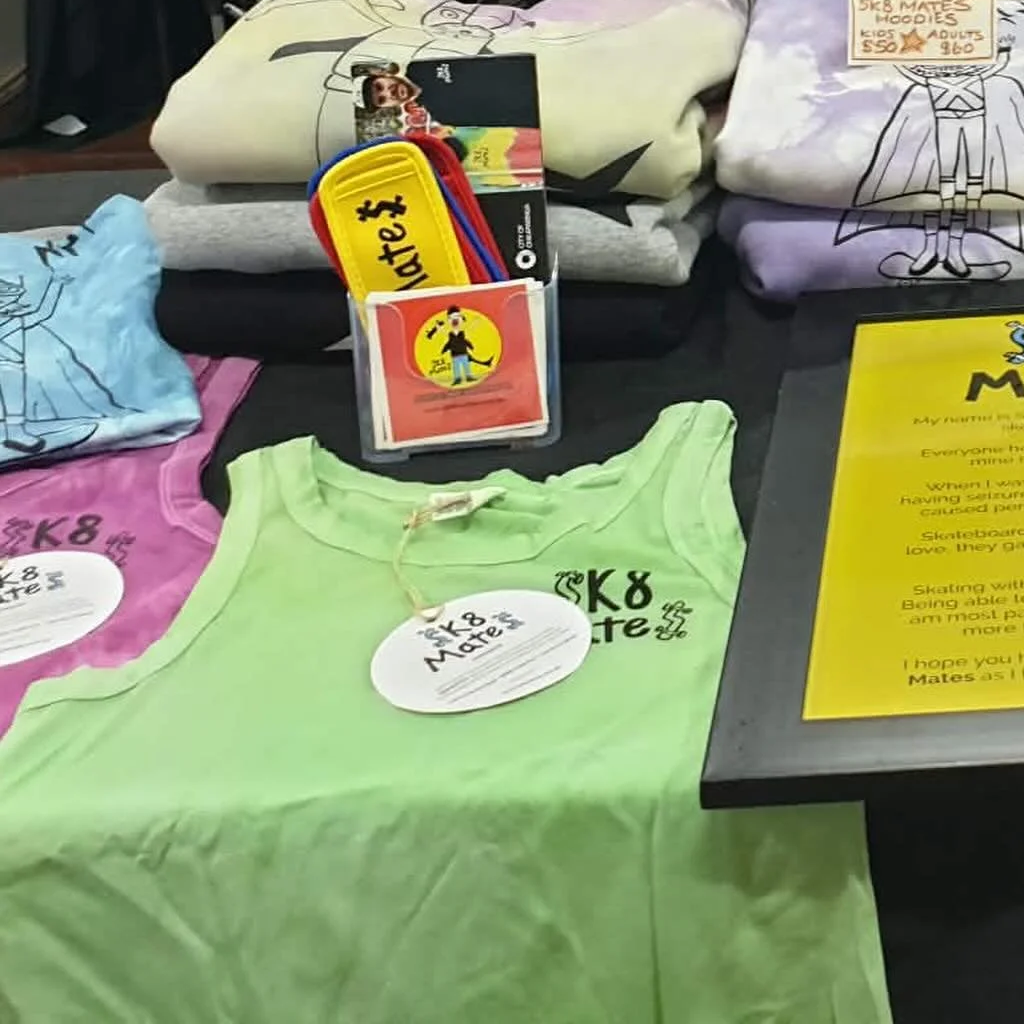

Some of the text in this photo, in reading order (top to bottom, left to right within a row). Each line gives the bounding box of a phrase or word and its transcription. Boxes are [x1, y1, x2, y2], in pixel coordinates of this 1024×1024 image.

[899, 0, 971, 13] MATES
[875, 13, 959, 26] HOODIES
[860, 29, 984, 41] KIDS ADULTS
[862, 39, 975, 56] $50 $60
[926, 482, 980, 491] When
[900, 495, 960, 505] having
[920, 504, 988, 516] caused
[957, 544, 997, 552] they
[554, 568, 654, 614] SK8
[913, 584, 985, 595] Skating
[902, 600, 958, 610] Being
[964, 596, 1007, 606] able
[909, 615, 942, 624] am
[416, 611, 488, 649] SK8
[963, 625, 1016, 635] more
[423, 608, 526, 673] Mates
[915, 658, 968, 669] hope
[974, 656, 1011, 669] you
[908, 673, 975, 685] Mates
[980, 672, 1004, 681] as
